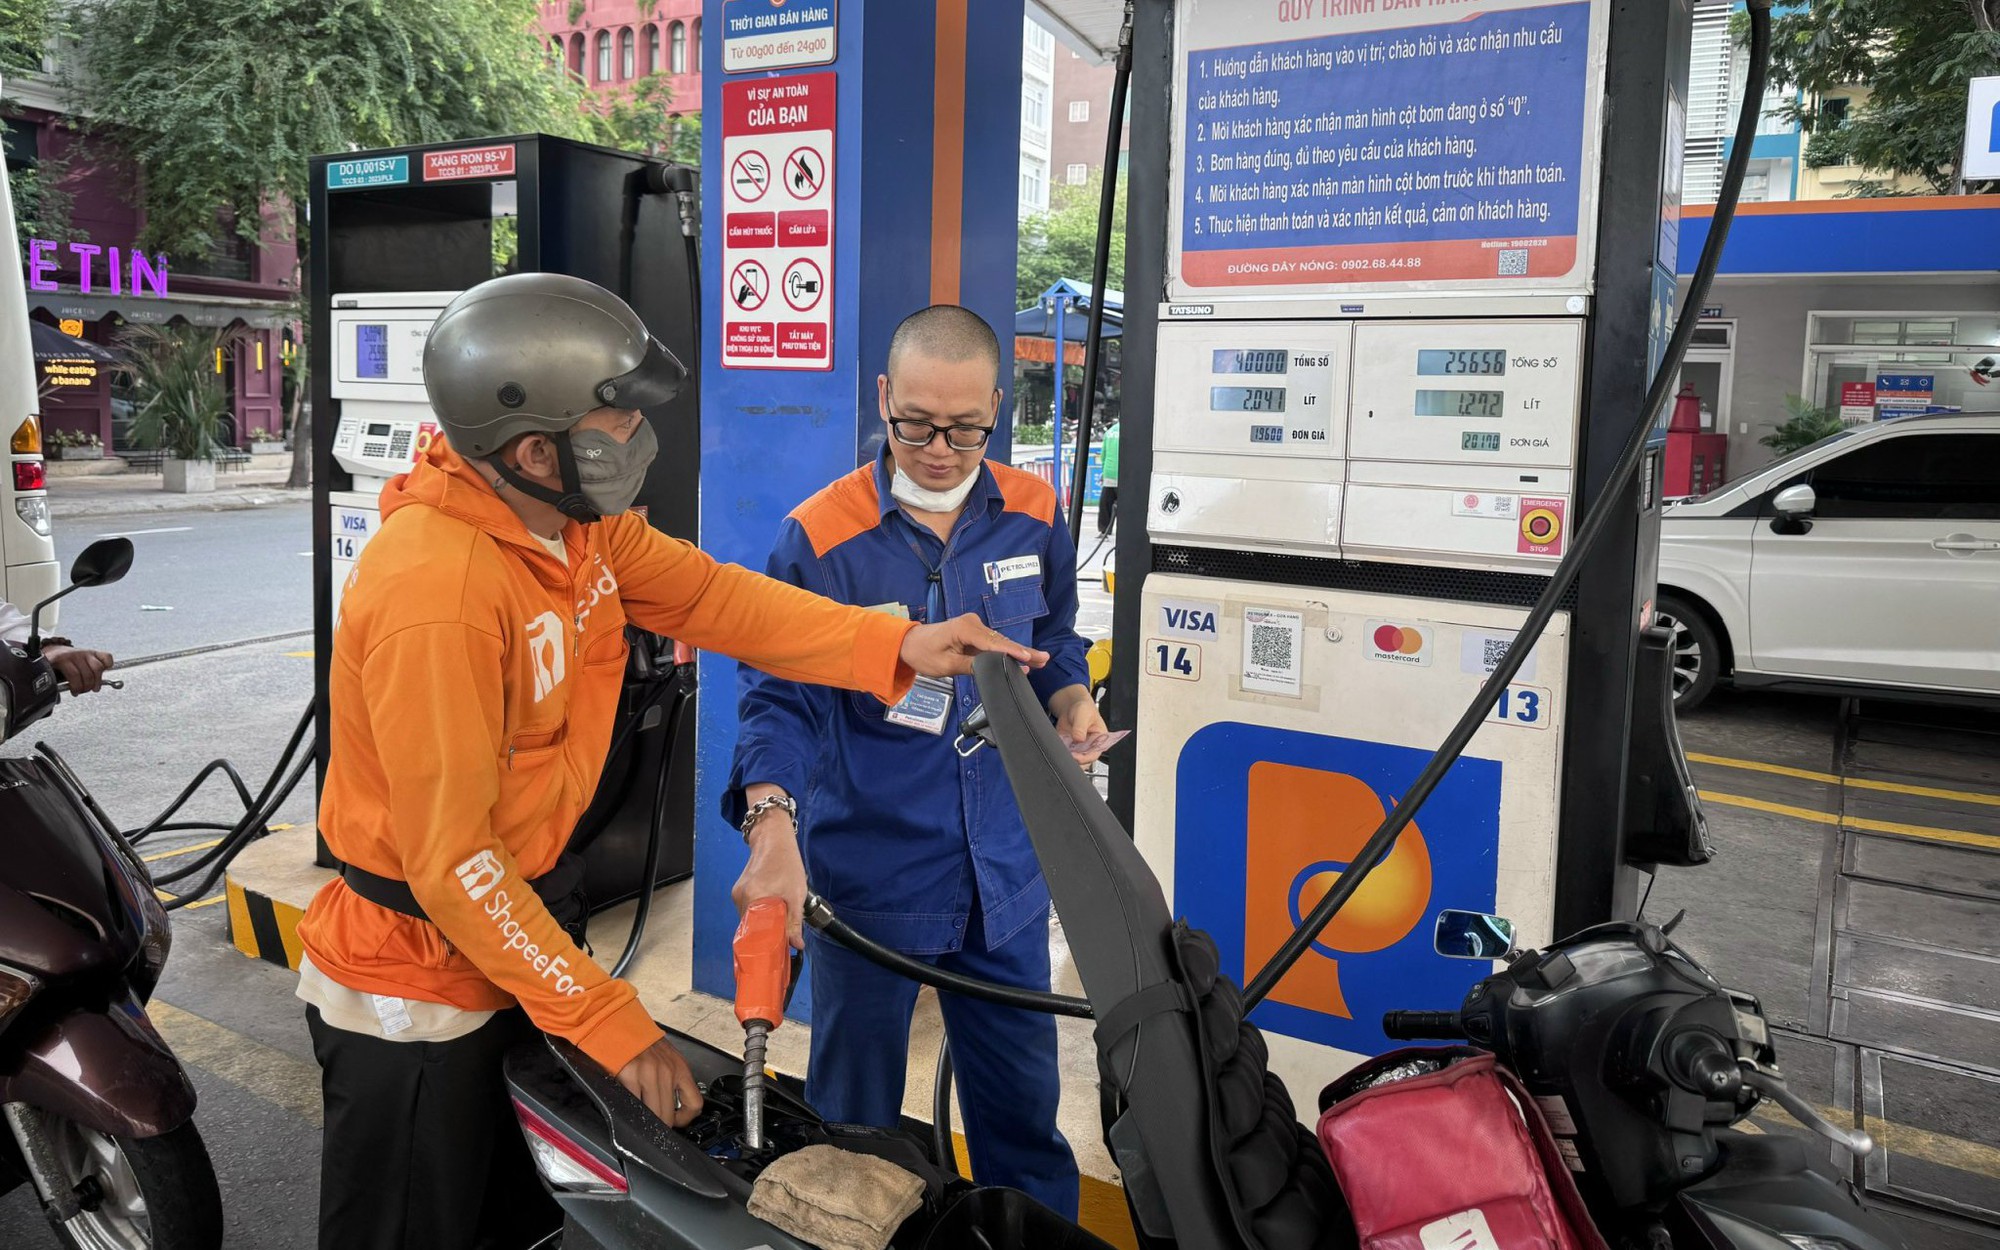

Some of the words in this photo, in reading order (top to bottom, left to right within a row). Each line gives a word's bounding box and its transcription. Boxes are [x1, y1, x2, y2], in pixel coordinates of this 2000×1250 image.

[730, 15, 753, 31] THỜI
[755, 14, 777, 28] GIAN
[780, 10, 799, 25] BÁN
[801, 7, 828, 23] HÀNG
[1278, 0, 1312, 22] QUY
[732, 47, 743, 59] Từ
[746, 44, 774, 59] 00g00
[776, 41, 794, 55] đến
[797, 38, 826, 54] 24g00
[1200, 60, 1208, 79] 1.
[1250, 51, 1268, 73] dẫn
[1271, 51, 1302, 72] khách
[1306, 49, 1332, 71] hàng
[1335, 45, 1354, 64] vào
[1357, 45, 1367, 66] vị
[1370, 43, 1385, 64] trí;
[1388, 39, 1416, 59] chào
[1419, 34, 1437, 57] hỏi
[1439, 34, 1453, 54] và
[1456, 32, 1477, 53] xác
[1480, 29, 1510, 53] nhận
[1513, 26, 1536, 47] nhu
[1540, 21, 1563, 44] cầu
[747, 87, 755, 100] VÌ
[757, 88, 771, 102] SỰ
[772, 87, 784, 98] AN
[786, 83, 808, 97] TOÀN
[1198, 90, 1216, 110] của
[1219, 88, 1249, 107] khách
[1252, 86, 1281, 109] hàng.
[748, 103, 775, 126] CỦA
[780, 105, 808, 127] BẠN
[1197, 123, 1206, 142] 2.
[1211, 121, 1229, 141] Mời
[1232, 119, 1262, 140] khách
[1265, 116, 1291, 139] hàng
[1294, 115, 1312, 134] xác
[1315, 111, 1342, 136] nhận
[1345, 109, 1368, 129] màn
[1371, 106, 1396, 127] hình
[1400, 105, 1417, 129] cột
[1420, 106, 1444, 124] bơm
[1448, 101, 1476, 123] đang
[1479, 97, 1487, 118] ở
[1490, 95, 1505, 117] số
[461, 153, 483, 165] RON
[485, 151, 508, 163] 95-V
[1196, 155, 1205, 173] 3.
[1211, 154, 1233, 172] Bơm
[1236, 151, 1261, 174] hàng
[1264, 149, 1293, 171] đúng,
[1296, 145, 1309, 165] đủ
[1312, 146, 1335, 164] theo
[1338, 144, 1357, 167] yêu
[1361, 139, 1380, 160] cầu
[1383, 138, 1404, 159] của
[1407, 137, 1441, 158] khách
[1445, 135, 1477, 159] hàng.
[339, 164, 353, 176] DO
[438, 168, 454, 177] TCCS
[1195, 185, 1204, 204] 4.
[1210, 184, 1227, 203] Mời
[1229, 182, 1260, 202] khách
[1262, 181, 1288, 203] hàng
[1290, 179, 1309, 198] xác
[1312, 177, 1338, 200] nhận
[1341, 175, 1364, 194] màn
[1368, 173, 1392, 193] hình
[1395, 171, 1413, 195] cột
[1415, 171, 1440, 190] bơm
[1443, 167, 1474, 189] trước
[1477, 166, 1495, 187] khi
[1498, 164, 1532, 185] thanh
[1536, 162, 1566, 184] toán.
[1194, 217, 1203, 234] 5.
[1209, 215, 1233, 237] Thực
[1236, 212, 1257, 237] hiện
[1260, 211, 1288, 231] thanh
[1292, 210, 1314, 230] toán
[1317, 209, 1330, 228] và
[1332, 208, 1351, 227] xác
[1354, 206, 1382, 230] nhận
[1384, 203, 1402, 225] kết
[1405, 202, 1429, 228] quả,
[1432, 201, 1456, 223] cảm
[1460, 203, 1474, 221] ơn
[1478, 199, 1514, 220] khách
[1517, 197, 1551, 222] hàng.
[729, 227, 742, 237] CẤM
[789, 226, 802, 235] CẤM
[1227, 261, 1269, 274] ĐƯỜNG
[1272, 260, 1296, 273] DÂY
[1300, 259, 1338, 272] NÓNG:
[1341, 257, 1422, 271] 0902.68.44.88
[1171, 306, 1212, 315] TATSUNO
[1235, 352, 1285, 372] 40000
[1294, 355, 1315, 367] TỔNG
[1317, 354, 1330, 367] SỐ
[1445, 351, 1504, 373] 25656
[1511, 356, 1539, 368] TỔNG
[1543, 356, 1558, 368] SỐ
[45, 364, 68, 374] while
[69, 366, 97, 377] eating
[58, 376, 91, 386] banana
[1303, 393, 1316, 406] LÍT
[1523, 398, 1541, 410] LÍT
[1254, 426, 1283, 442] 19600
[1292, 428, 1309, 440] ĐƠN
[1312, 428, 1325, 441] GIÁ
[1463, 433, 1499, 450] 20170
[1510, 438, 1531, 447] ĐƠN
[1533, 437, 1549, 448] GIÁ
[1522, 499, 1562, 508] EMERGENCY
[342, 514, 367, 532] VISA
[336, 537, 353, 558] 16
[1529, 545, 1549, 553] STOP
[1162, 606, 1216, 633] VISA
[1156, 644, 1192, 676] 14
[1374, 652, 1420, 663] mastercard
[1497, 688, 1539, 723] 13
[484, 890, 586, 997] ShopeeFoo
